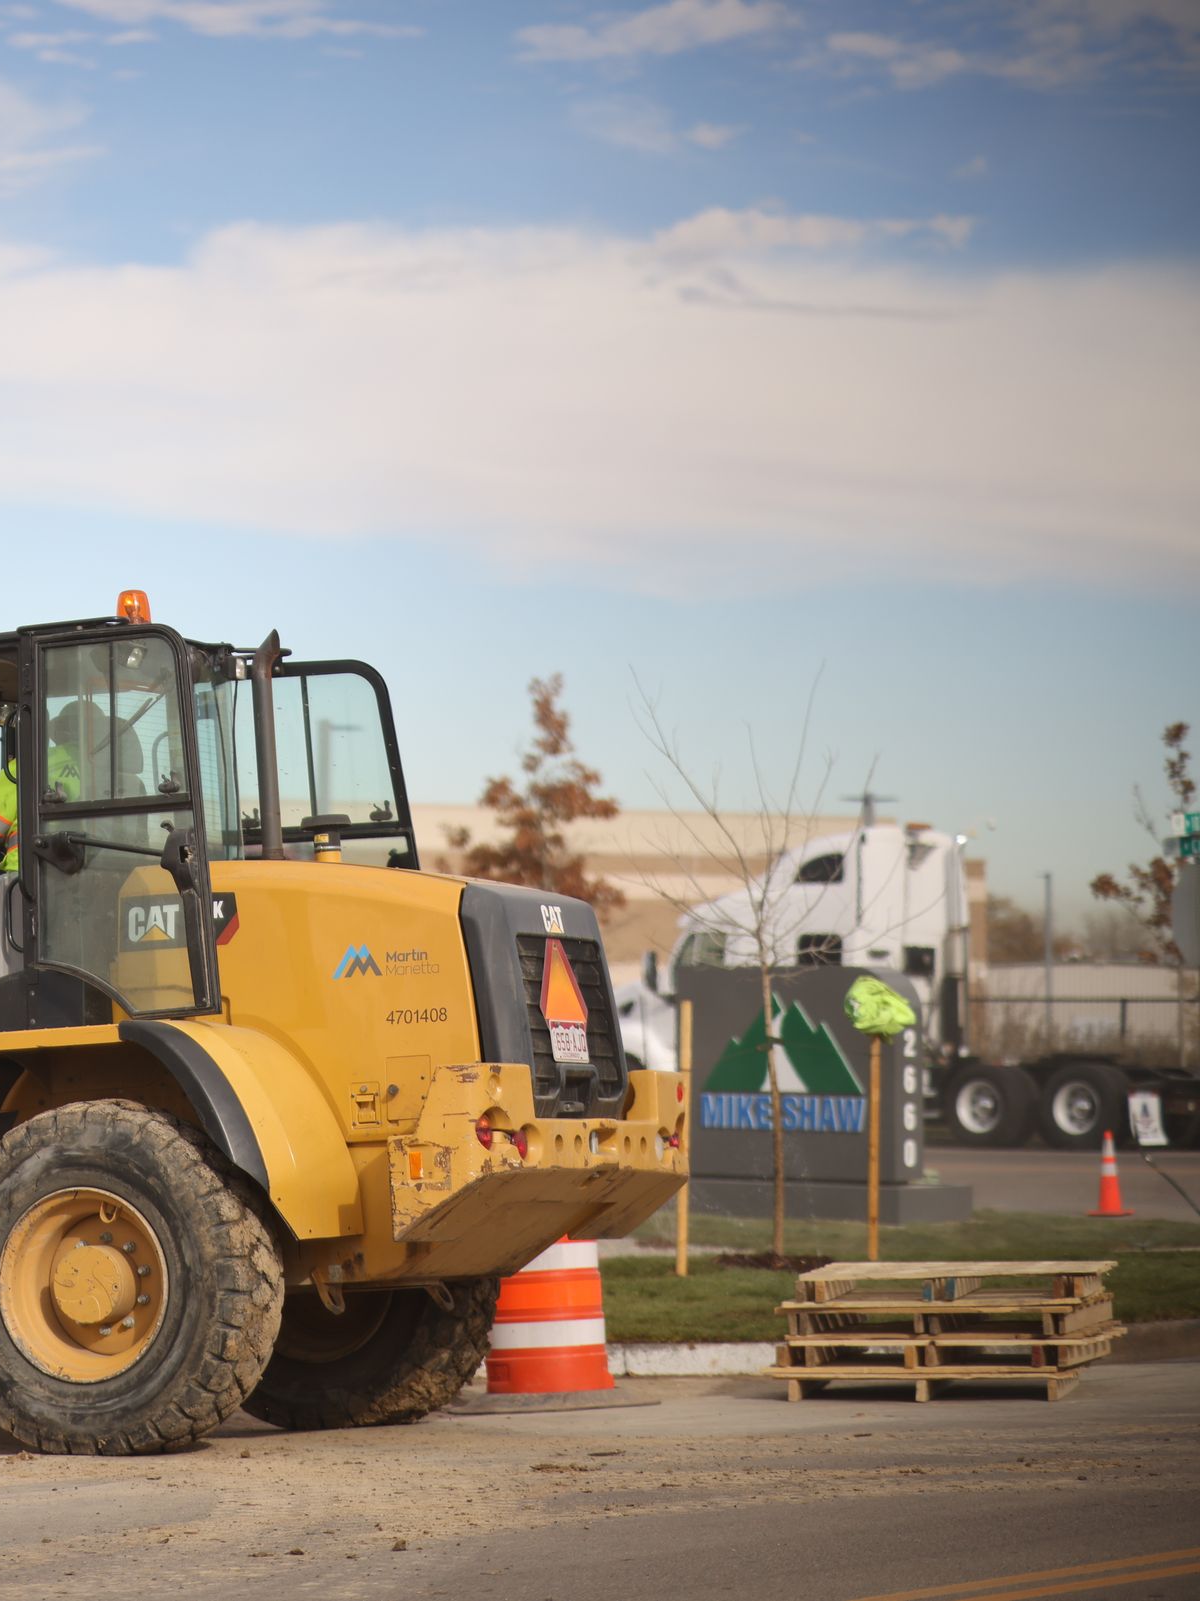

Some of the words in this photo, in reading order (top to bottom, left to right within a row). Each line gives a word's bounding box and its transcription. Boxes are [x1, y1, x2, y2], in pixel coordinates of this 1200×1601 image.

[128, 904, 180, 942] CAT
[540, 904, 565, 934] CAT
[385, 963, 440, 976] Marietta
[386, 949, 428, 963] Martin
[386, 1007, 448, 1025] 4701408
[903, 1028, 917, 1168] 2660
[702, 1094, 775, 1130] MIKE
[780, 1095, 867, 1133] SHAW
